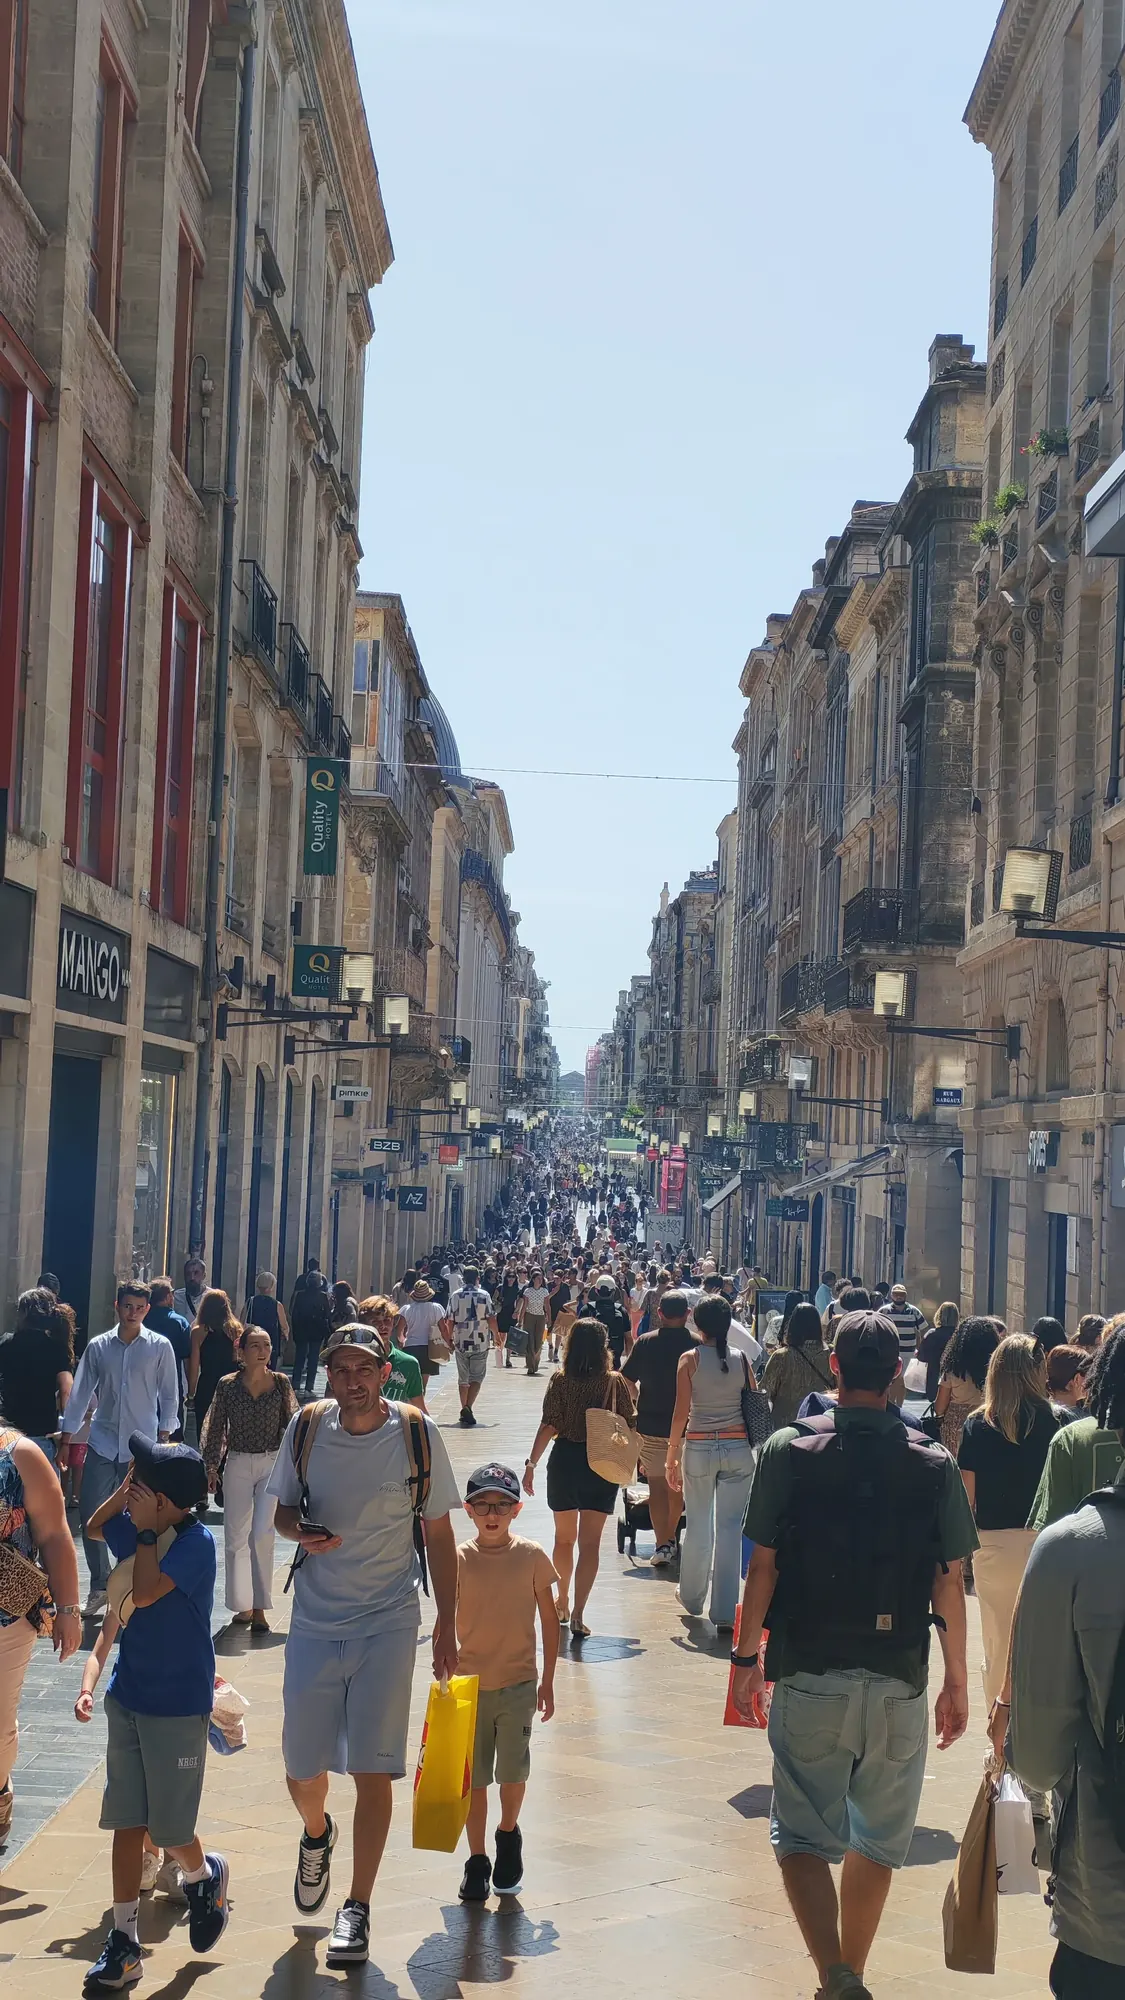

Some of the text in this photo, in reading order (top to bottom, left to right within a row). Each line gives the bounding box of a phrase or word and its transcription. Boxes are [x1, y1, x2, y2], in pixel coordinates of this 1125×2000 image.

[311, 770, 336, 791] Q
[311, 801, 328, 853] Quality
[60, 928, 120, 1001] MANGO
[373, 1141, 400, 1151] BZB
